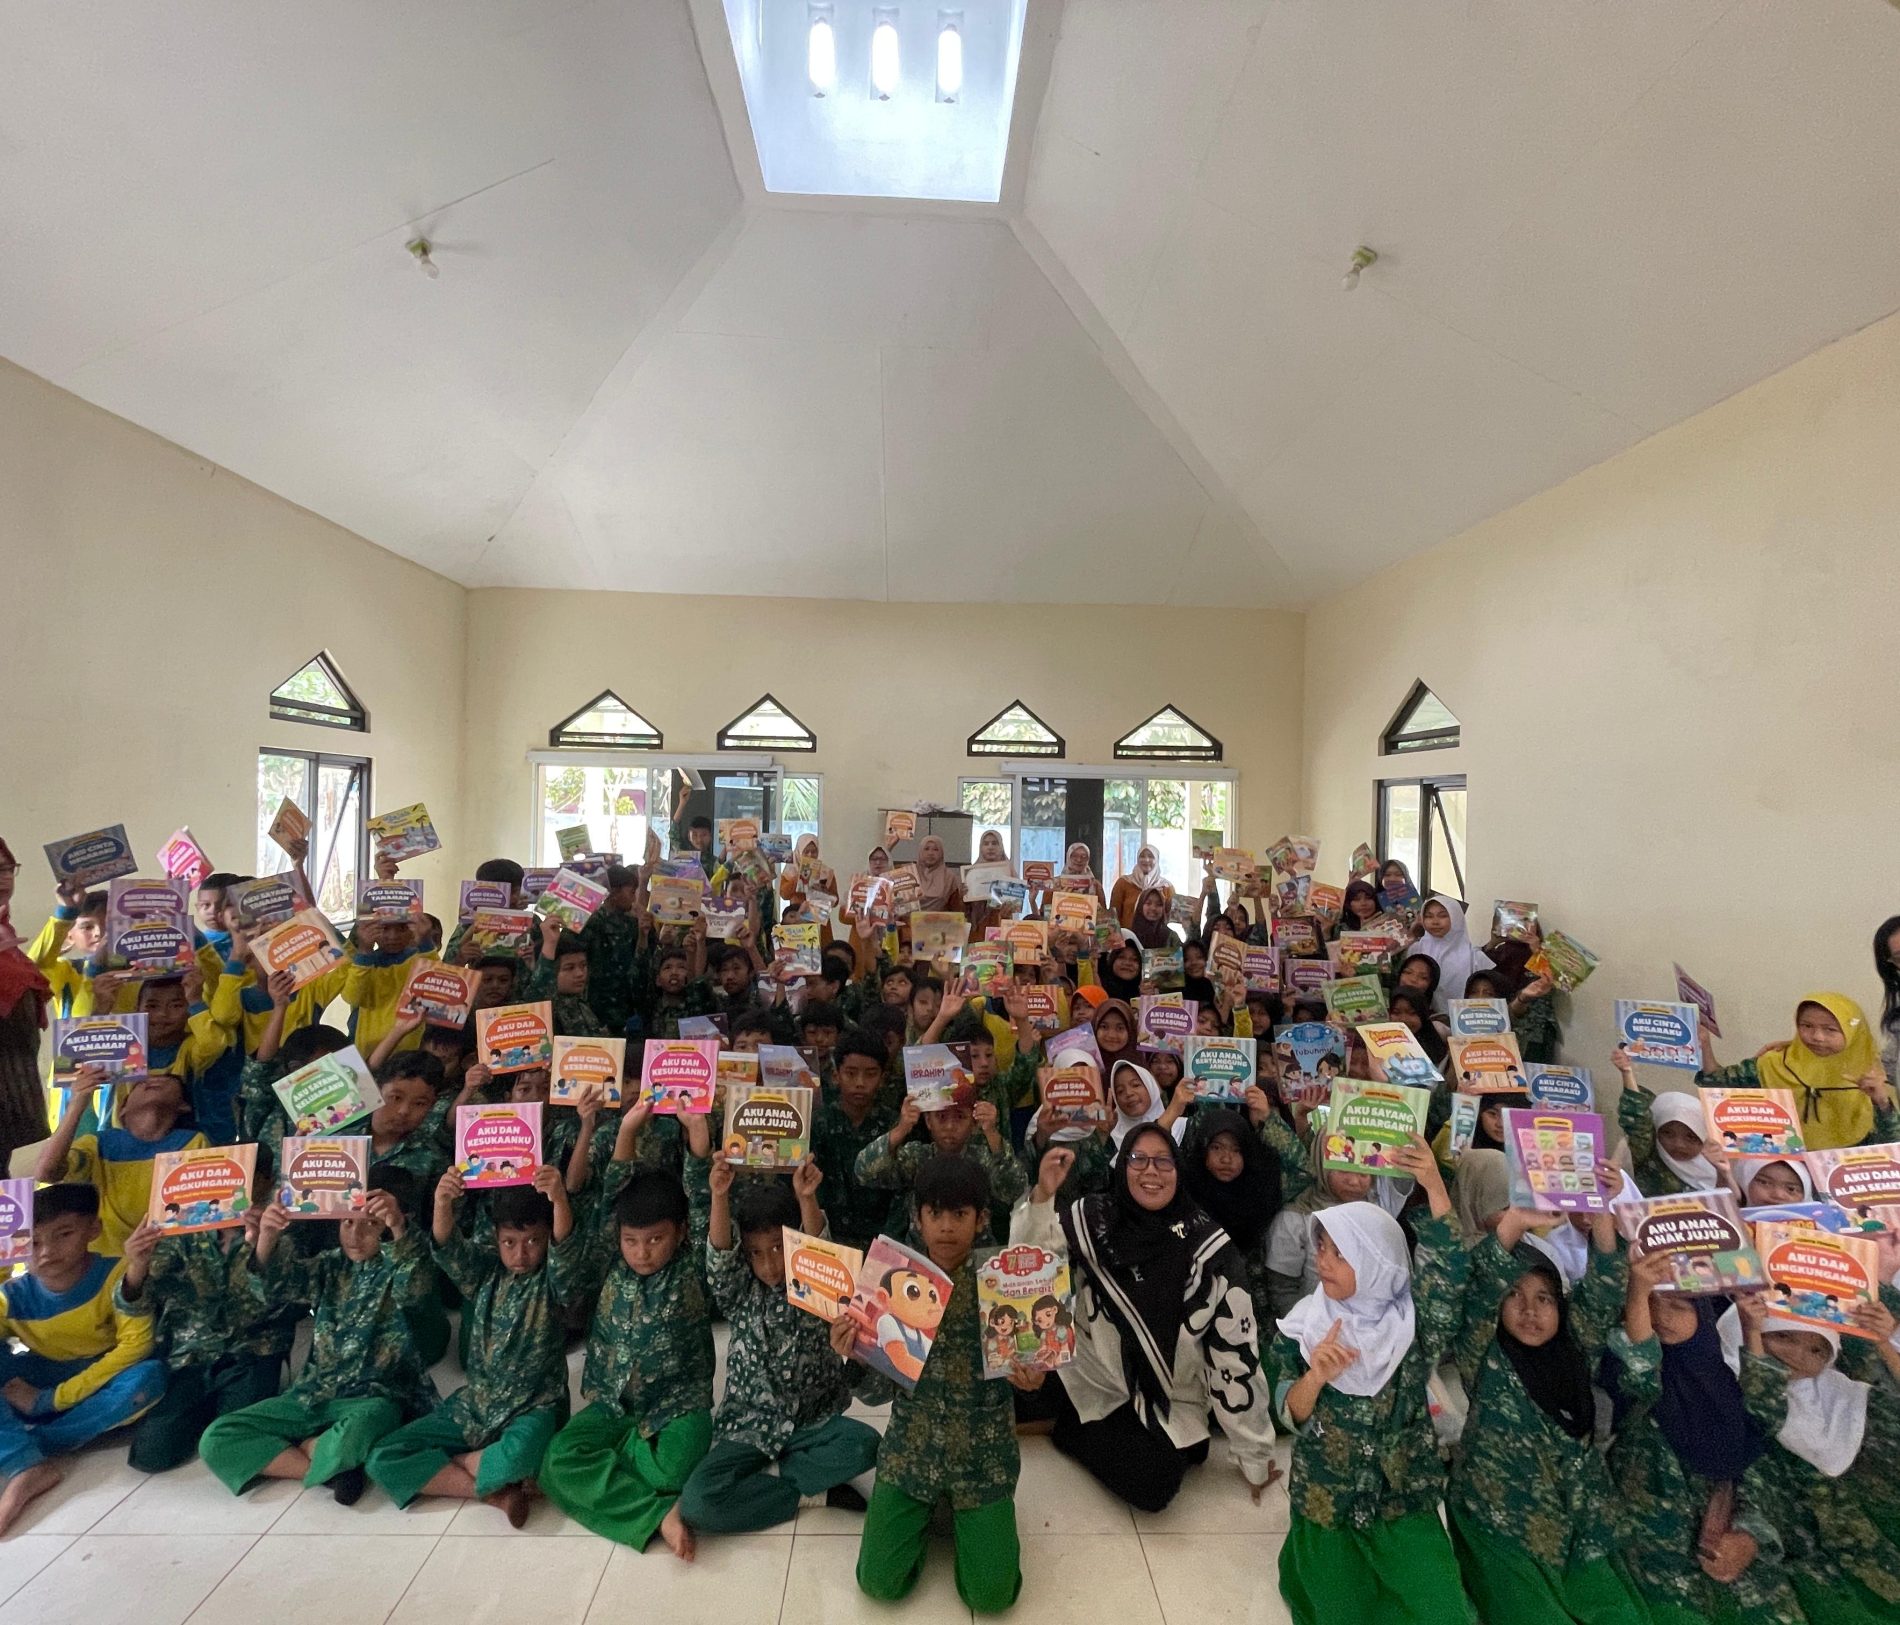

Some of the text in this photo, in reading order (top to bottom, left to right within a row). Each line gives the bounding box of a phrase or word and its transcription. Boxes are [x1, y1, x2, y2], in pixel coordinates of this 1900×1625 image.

[260, 887, 293, 899] SAYANG
[120, 933, 183, 946] AKU SAYANG
[273, 930, 314, 956] AKU CINTA
[126, 941, 176, 951] TANAMAN
[424, 976, 460, 990] AKU DAN
[413, 983, 462, 998] KENDARAAN
[497, 1020, 535, 1032] AKU DAN
[1652, 1018, 1682, 1030] CINTA
[486, 1028, 546, 1043] LINGKUNGANKU
[1632, 1026, 1682, 1036] NEGARAKU
[66, 1034, 134, 1044] AKU SAYANG
[72, 1042, 126, 1052] TANAMAN
[586, 1056, 610, 1064] CINTA
[1218, 1052, 1243, 1060] ANAK
[1466, 1050, 1482, 1058] AKU
[662, 1058, 680, 1066] AKU
[652, 1068, 708, 1076] KESUKAANKU
[911, 1068, 944, 1079] IBRAHIM
[743, 1108, 794, 1120] AKU ANAK
[1346, 1105, 1414, 1124] AKU SAYANG
[1727, 1106, 1775, 1115] AKU DAN
[738, 1118, 798, 1129] ANAK JUJUR
[1715, 1116, 1791, 1125] LINGKUNGANKU
[478, 1126, 520, 1136] AKU DAN
[467, 1136, 532, 1147] KESUKAANKU
[302, 1160, 346, 1168] AKU DAN
[180, 1168, 231, 1182] AKU DAN
[292, 1170, 356, 1179] ALAM SEMESTA
[1844, 1170, 1900, 1184] AKU DAN
[164, 1178, 244, 1195] LINGKUNGANKU
[1834, 1184, 1868, 1196] ALAM
[1648, 1218, 1720, 1236] AKU ANAK
[1646, 1229, 1730, 1247] ANAK JUJUR
[798, 1255, 846, 1281] AKU CINTA
[1788, 1252, 1850, 1272] AKU DAN
[796, 1264, 849, 1293] KEBERSIHAN
[1770, 1262, 1867, 1288] LINGKUNGANKU
[1004, 1286, 1054, 1298] dan Bergizi
